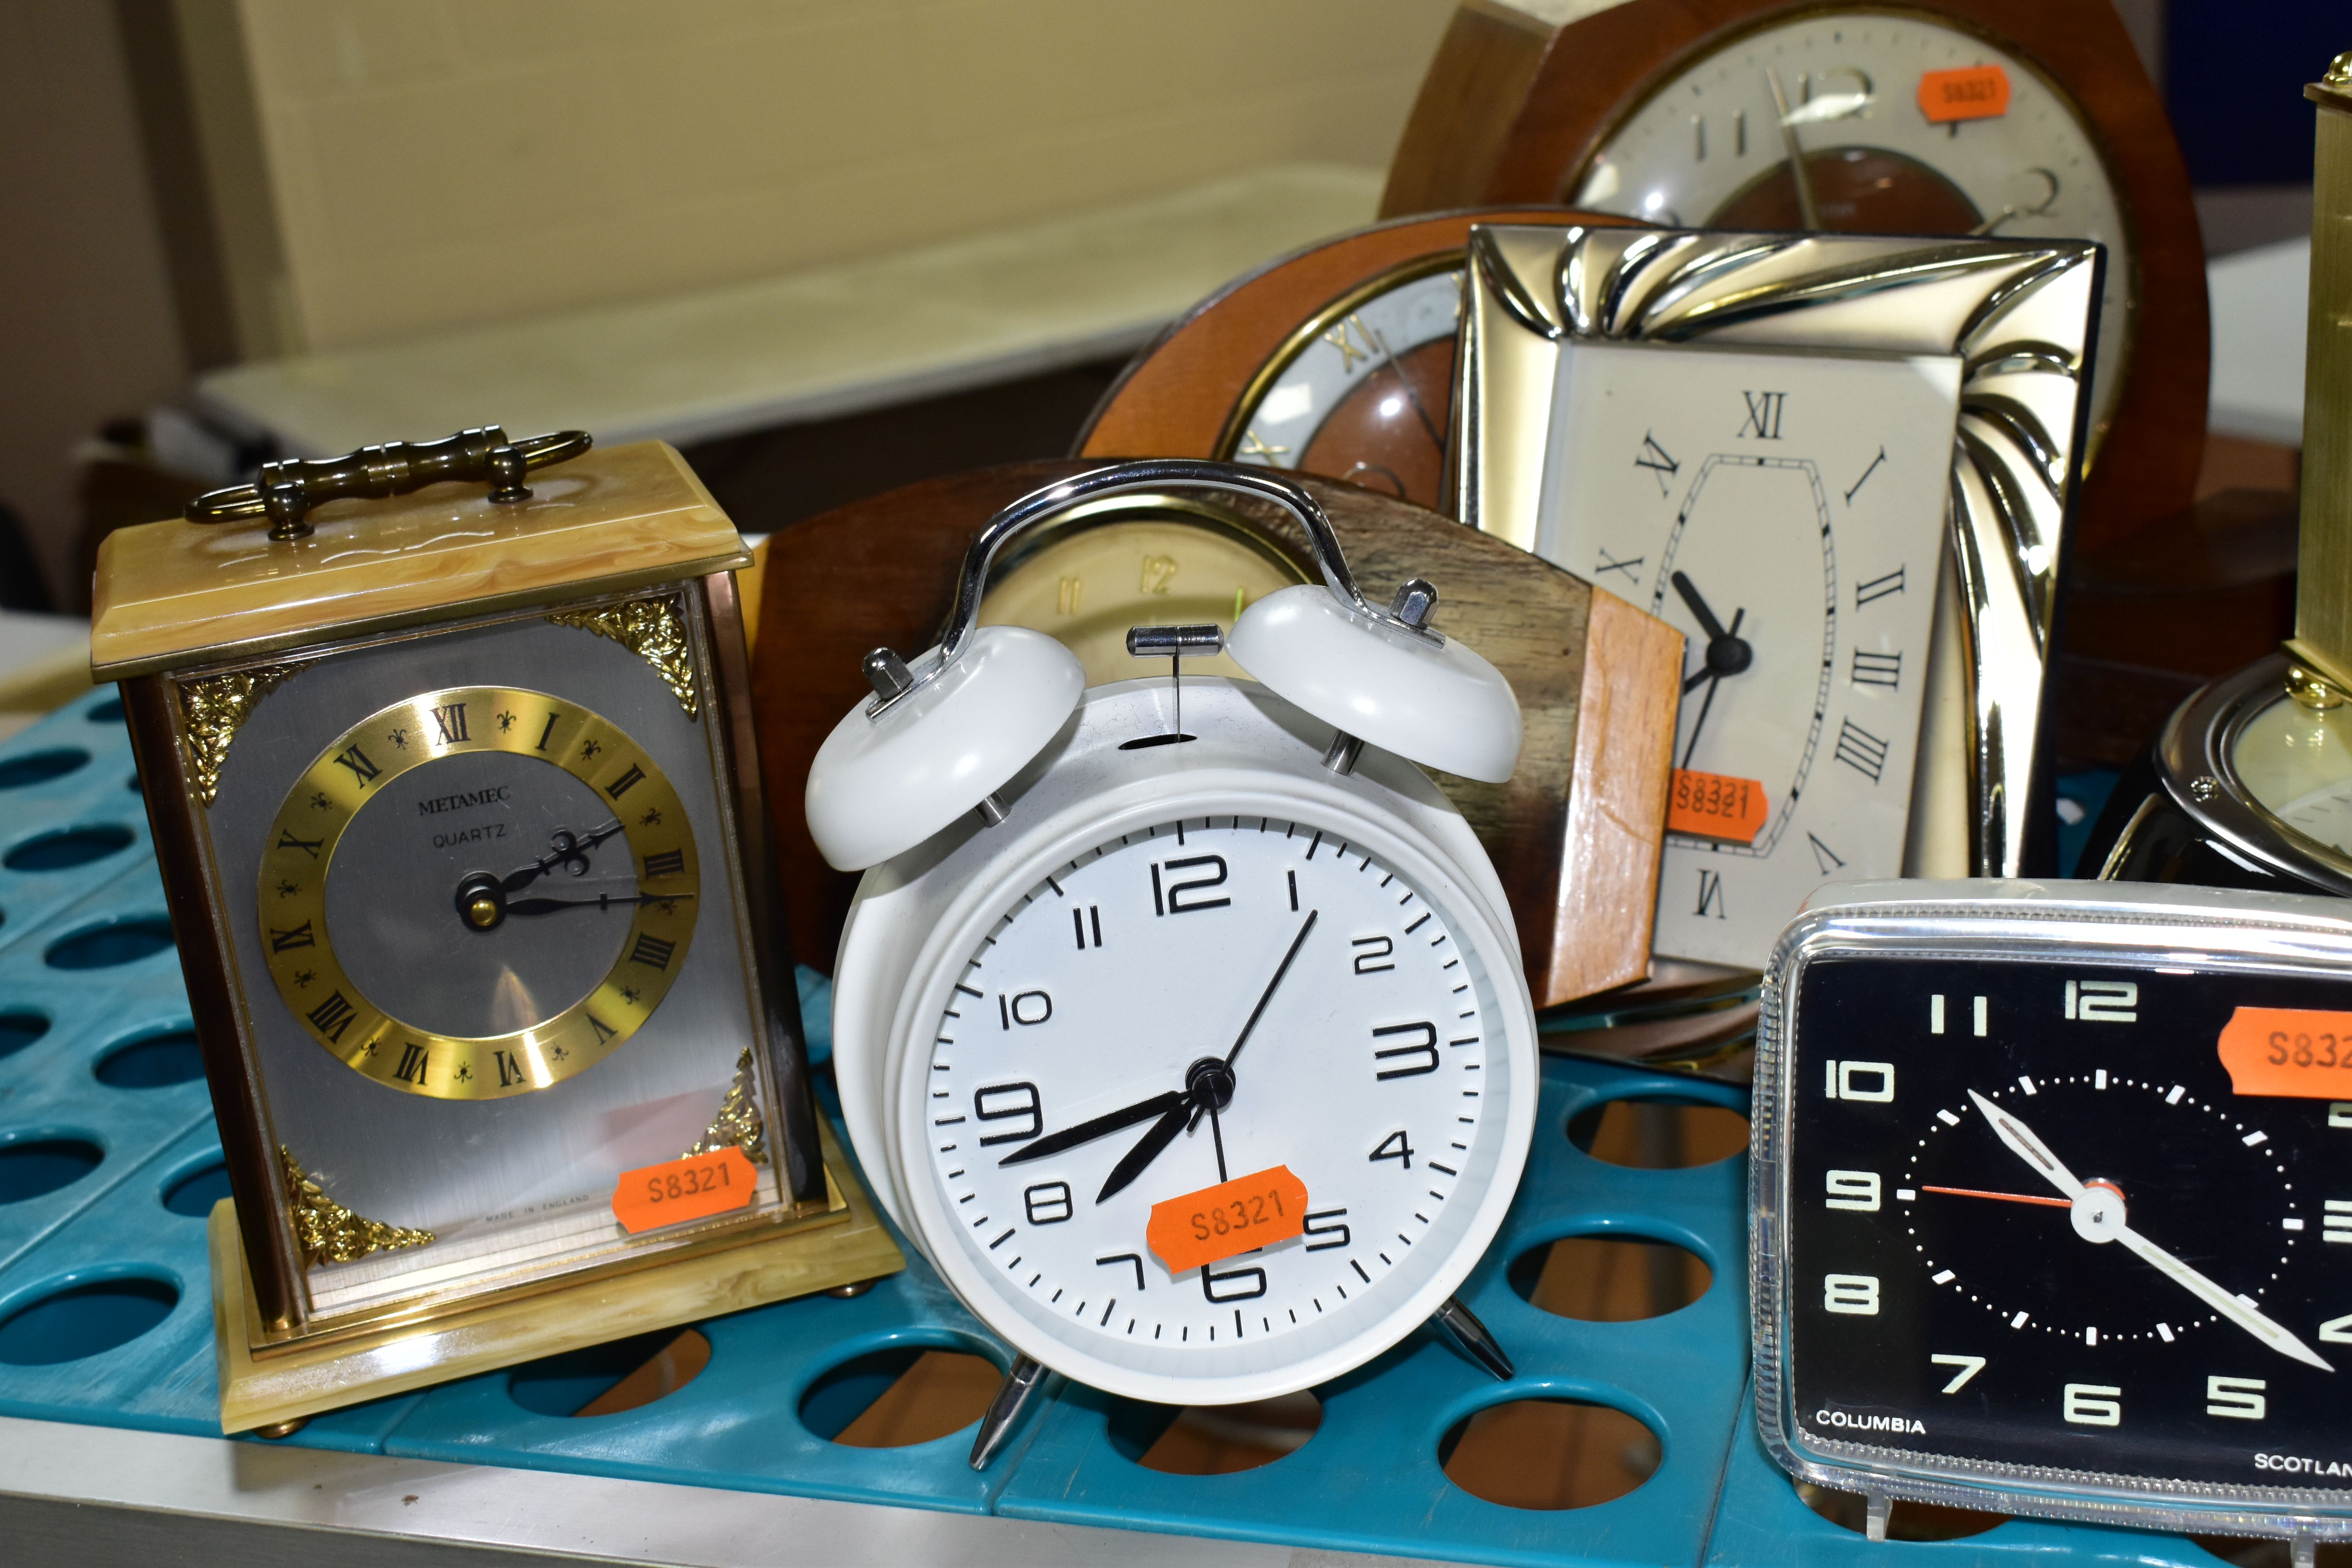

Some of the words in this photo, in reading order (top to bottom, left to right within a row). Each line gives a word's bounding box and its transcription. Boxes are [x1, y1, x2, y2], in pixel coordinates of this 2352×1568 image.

[1691, 108, 1747, 161] 11
[1324, 313, 1379, 375] XI
[1738, 390, 1786, 439] XII
[1635, 429, 1680, 498] XI
[1845, 446, 1886, 506] I
[1140, 554, 1177, 595] 12
[1595, 547, 1643, 584] X
[1060, 576, 1081, 615] 11
[1856, 565, 1905, 611] II
[1851, 648, 1902, 691] III
[431, 703, 472, 746] XII
[535, 712, 560, 751] I
[334, 744, 383, 789] XI
[1835, 716, 1889, 784] IIII
[418, 786, 510, 815] METAMEC
[605, 763, 646, 800] II
[277, 829, 324, 859] X
[433, 824, 506, 848] QUARTZ
[1807, 831, 1846, 875] V
[642, 848, 684, 880] III
[1151, 854, 1231, 916] 12
[1287, 870, 1298, 911] 1
[1693, 869, 1727, 919] VI
[270, 919, 316, 954] IX
[1073, 906, 1103, 949] 11
[629, 931, 677, 971] IIII
[1352, 936, 1395, 975] 2
[306, 989, 358, 1044] VIII
[999, 990, 1053, 1029] 10
[1931, 995, 1987, 1036] 11
[2065, 980, 2137, 1022] 12
[586, 1014, 618, 1046] V
[393, 1042, 428, 1085] VII
[493, 1050, 527, 1087] VI
[1373, 1021, 1440, 1081] 3
[1826, 1060, 1894, 1102] 10
[975, 1082, 1043, 1146] 9
[1370, 1131, 1414, 1169] 4
[648, 1162, 730, 1202] S8321
[1826, 1170, 1880, 1211] 9
[486, 1212, 513, 1221] MADE
[543, 1194, 589, 1209] ENGLAND
[1024, 1181, 1073, 1226] 8
[1191, 1189, 1284, 1240] S8321
[1303, 1208, 1350, 1251] 5
[1096, 1254, 1145, 1290] 7
[1201, 1247, 1267, 1303] 6
[1824, 1274, 1879, 1315] 8
[1931, 1354, 1986, 1394] 7
[2064, 1383, 2121, 1426] 6
[2207, 1376, 2266, 1419] 5
[1816, 1410, 1926, 1435] COLUMBIA
[2254, 1453, 2352, 1477] SCOTLAN
